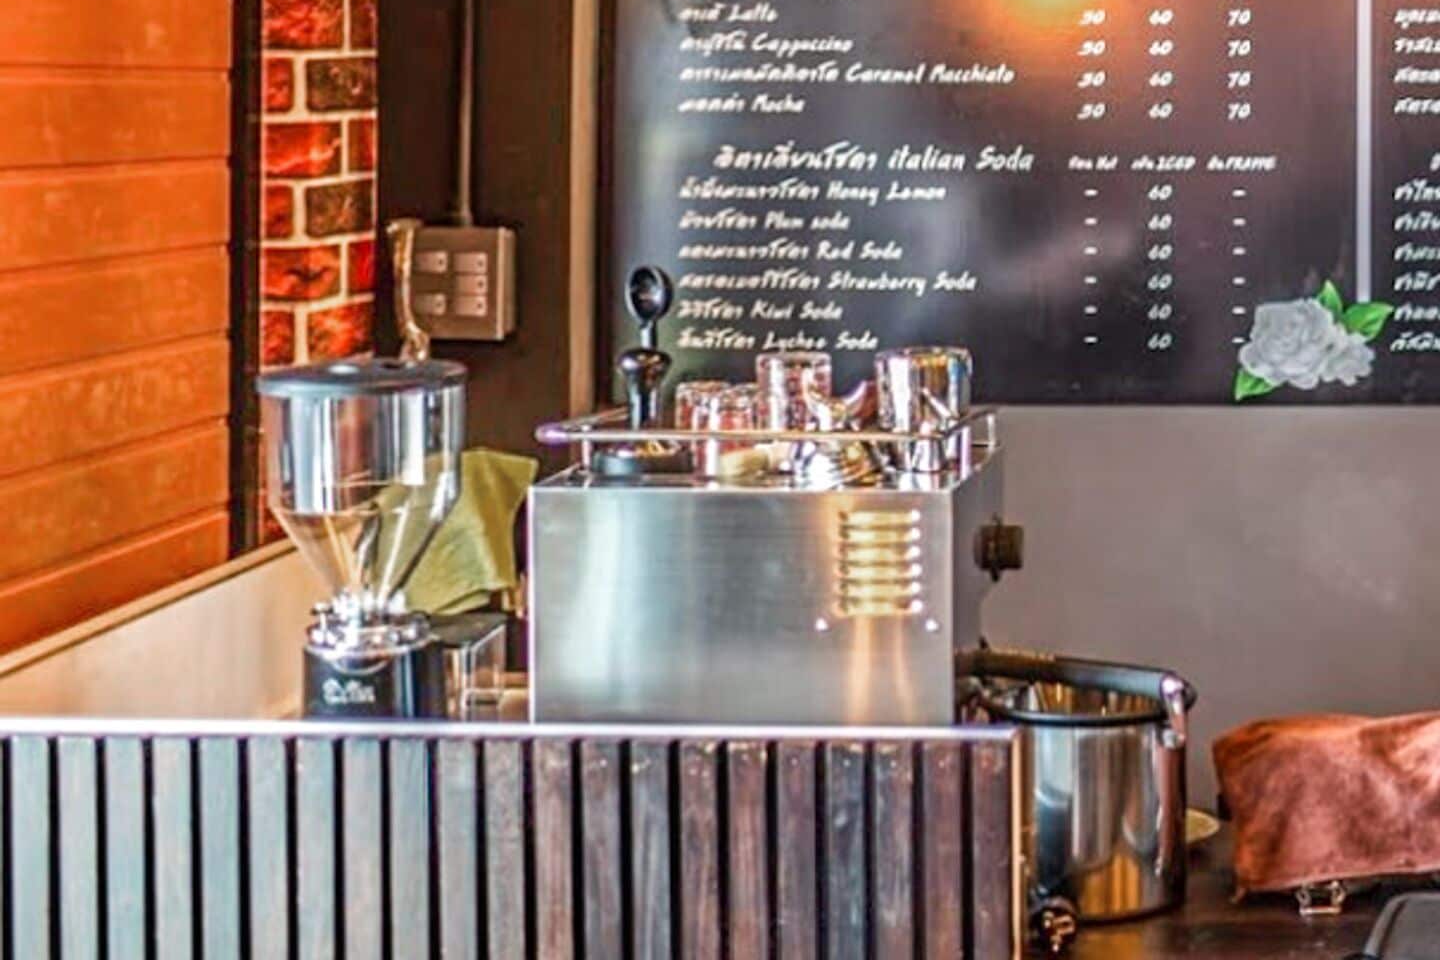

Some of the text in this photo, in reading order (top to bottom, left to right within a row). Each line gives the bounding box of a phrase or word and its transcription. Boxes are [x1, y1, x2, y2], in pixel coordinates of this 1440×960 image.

[1229, 9, 1250, 26] 70
[751, 32, 853, 58] Cappuccino
[1228, 40, 1250, 57] 70
[1228, 72, 1250, 88] 70
[1228, 103, 1250, 119] 70
[976, 145, 1034, 170] Soda
[886, 181, 946, 200] Lemon
[817, 240, 854, 259] Red
[859, 241, 902, 259] Soda
[933, 271, 976, 290] Soda
[799, 301, 842, 319] Soda
[835, 331, 878, 349] Soda
